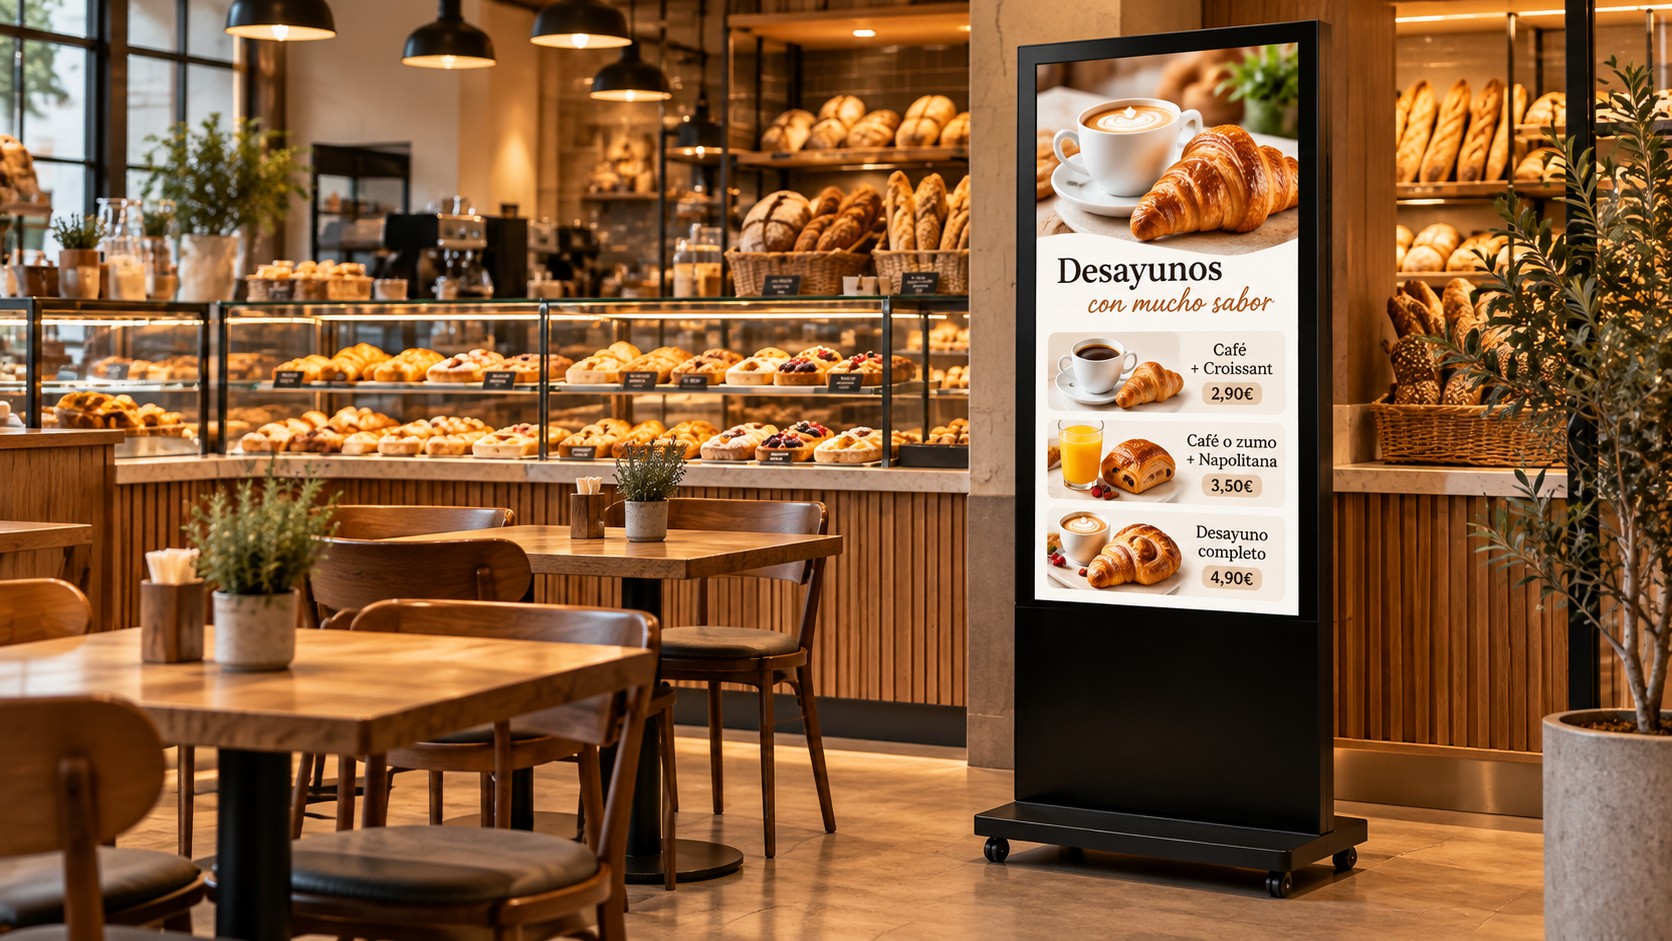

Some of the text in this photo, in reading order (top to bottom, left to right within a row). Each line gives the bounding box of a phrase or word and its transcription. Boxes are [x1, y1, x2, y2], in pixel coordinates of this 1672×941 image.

[1057, 257, 1223, 291] Desayunos
[1087, 286, 1274, 314] con mucho sabor
[1213, 342, 1247, 357] Café
[1190, 361, 1274, 376] + Croissant
[1211, 386, 1254, 403] 2,90€
[1186, 433, 1277, 450] Café o zumo
[1186, 452, 1278, 471] + Napolitana
[1211, 478, 1254, 495] 3,50€
[1196, 524, 1269, 543] Desayuno
[1197, 545, 1267, 562] completo
[1210, 570, 1254, 587] 4,90€
